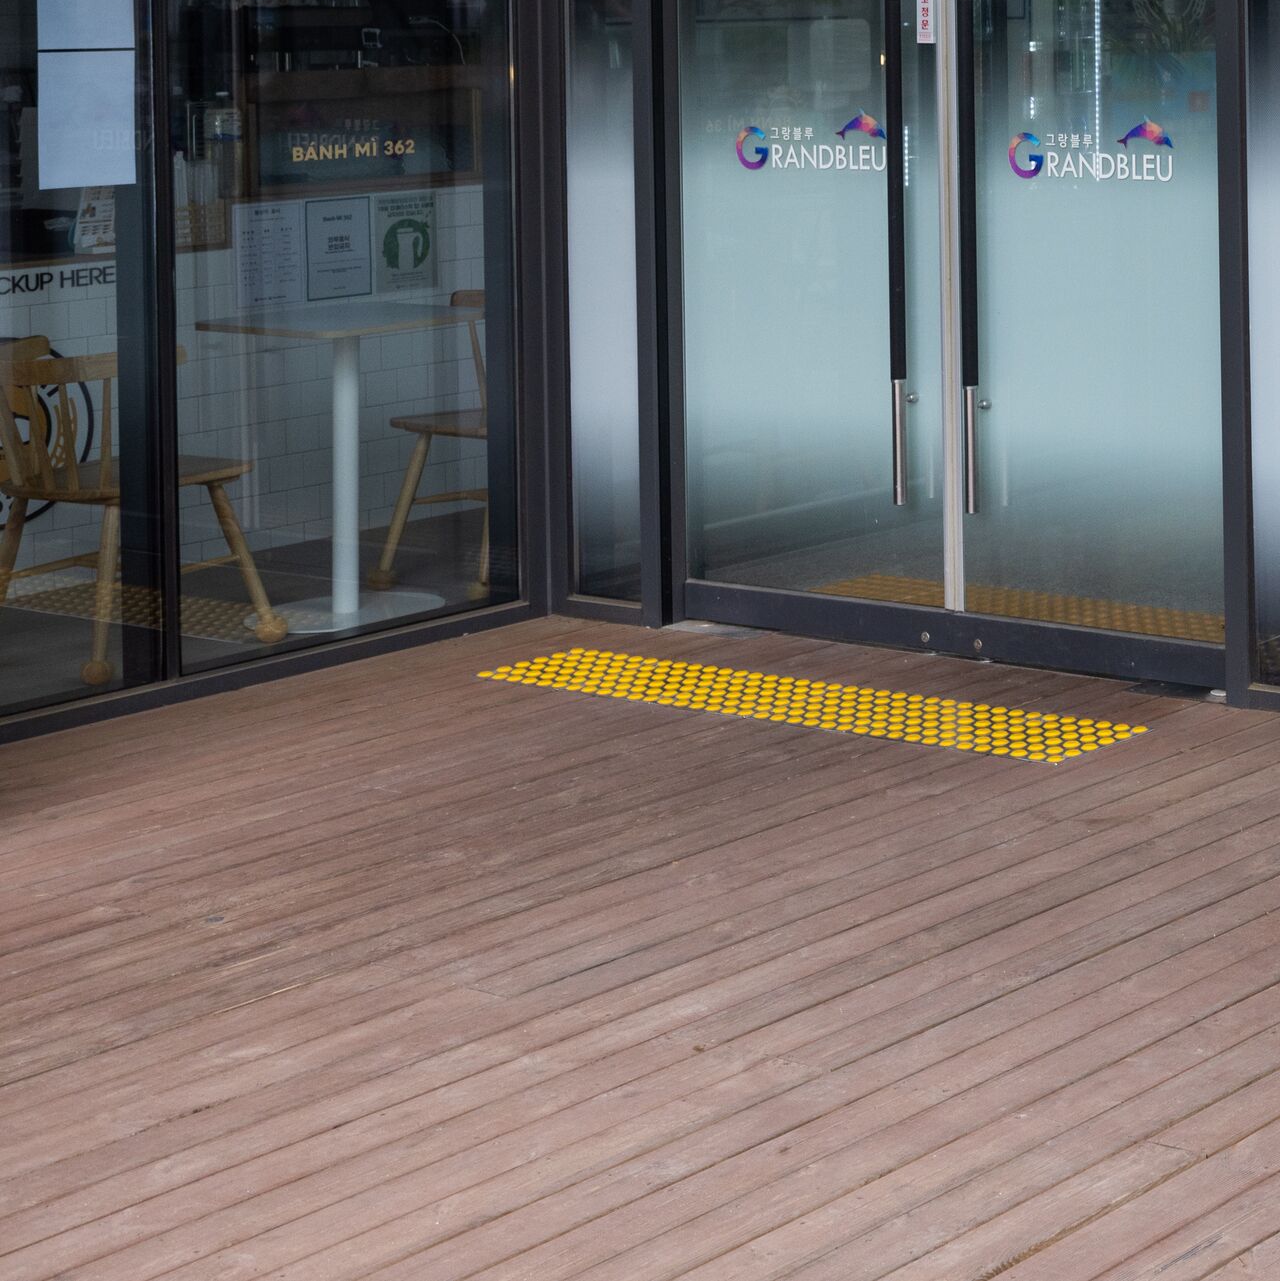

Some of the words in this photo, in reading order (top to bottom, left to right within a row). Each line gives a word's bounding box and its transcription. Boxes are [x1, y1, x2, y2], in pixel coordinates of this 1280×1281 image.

[770, 127, 814, 141] 그랑블루
[1045, 133, 1093, 148] 그랑블루
[292, 142, 348, 162] BÁNH
[355, 137, 378, 158] MÌ
[384, 139, 416, 156] 362
[735, 126, 887, 171] GRANDBLEU
[1008, 132, 1173, 182] GRANDBLEU
[60, 266, 115, 288] HERE
